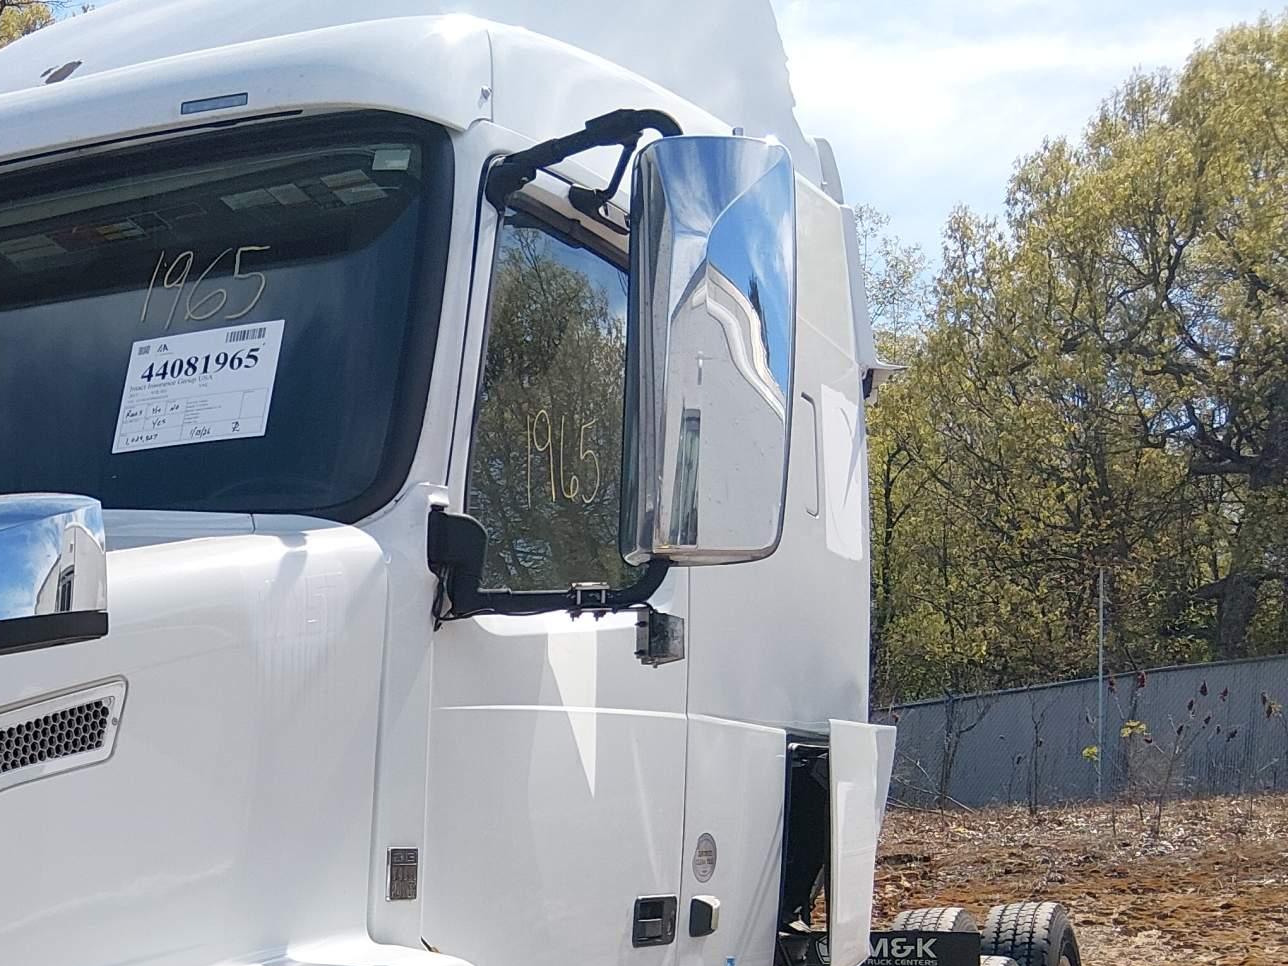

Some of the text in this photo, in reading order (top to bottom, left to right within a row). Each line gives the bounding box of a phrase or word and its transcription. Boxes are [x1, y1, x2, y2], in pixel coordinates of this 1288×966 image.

[141, 246, 271, 330] 1965
[141, 347, 261, 382] 44081965
[177, 377, 197, 385] Group
[527, 409, 600, 509] 1965
